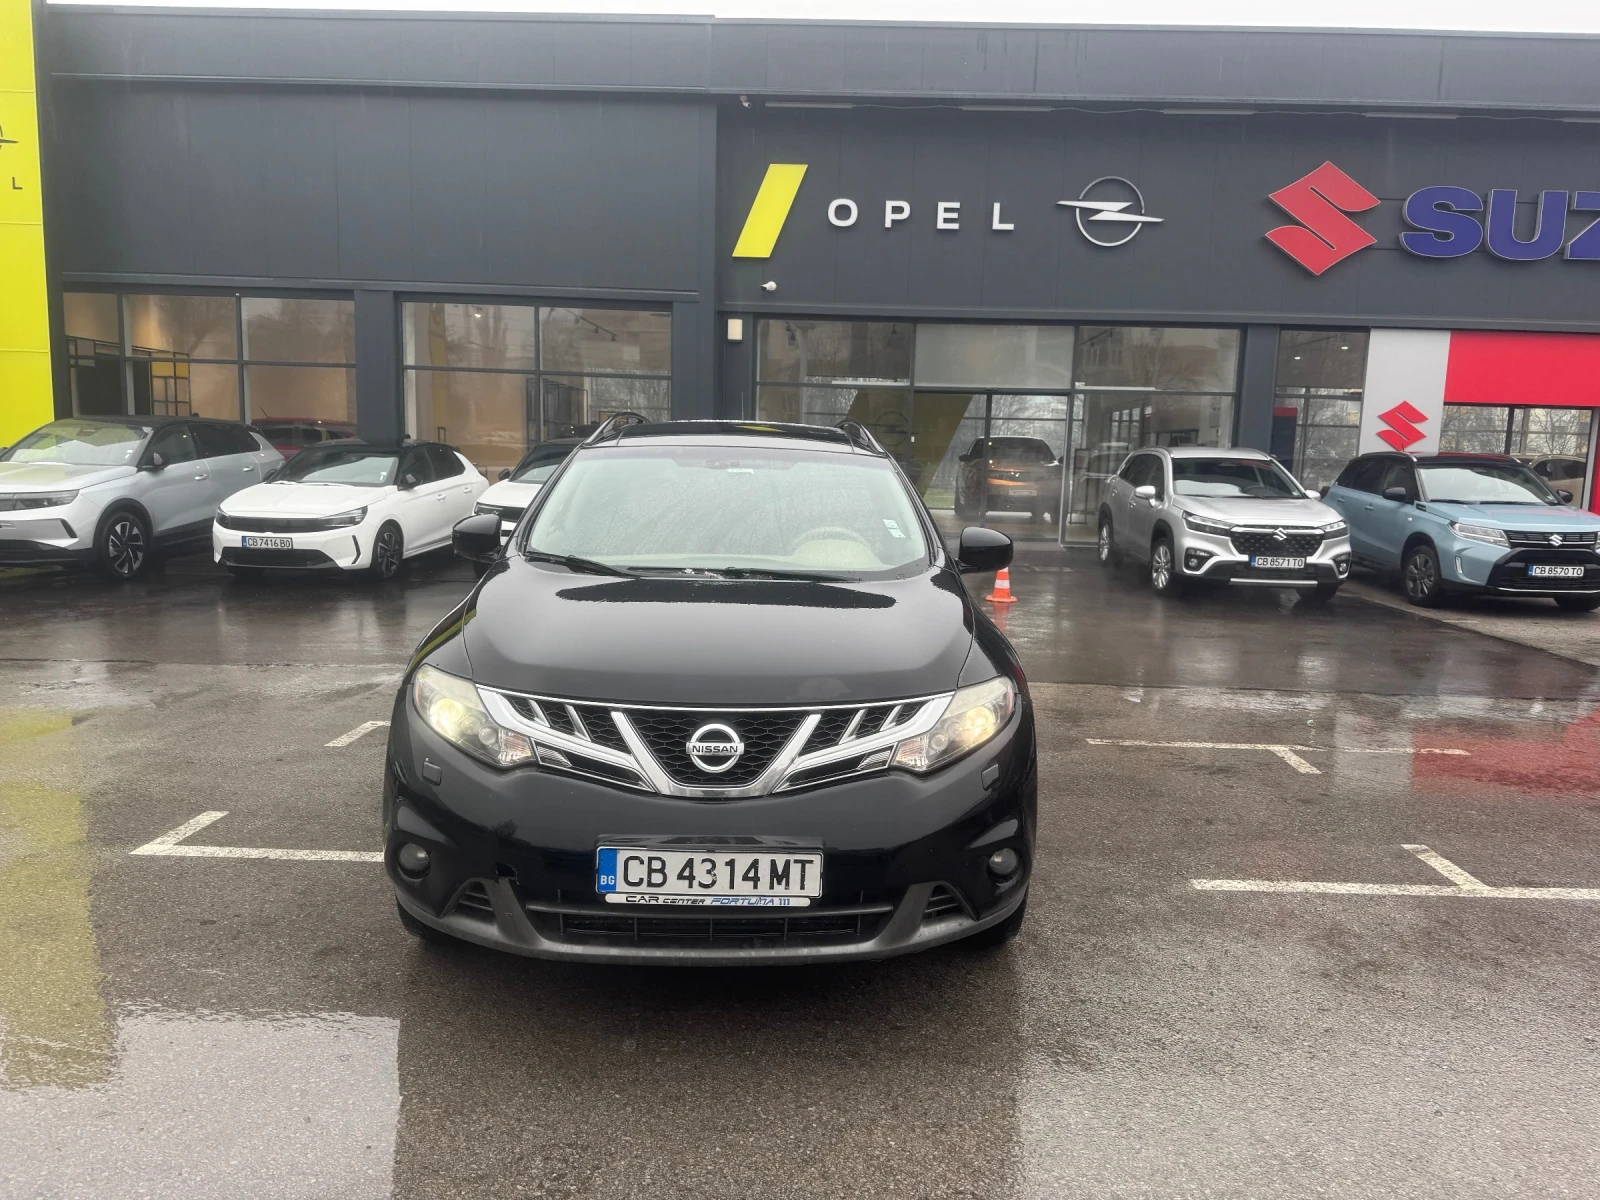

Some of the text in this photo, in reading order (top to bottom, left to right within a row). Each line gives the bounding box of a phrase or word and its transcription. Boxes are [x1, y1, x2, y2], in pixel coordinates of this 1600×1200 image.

[828, 198, 1015, 231] OPEL
[247, 537, 258, 547] CB
[259, 538, 279, 548] 7416
[1256, 557, 1269, 566] CB
[1269, 557, 1290, 567] 8571
[1534, 566, 1546, 575] CB
[1547, 566, 1570, 576] 8570
[692, 745, 738, 753] NISSAN
[623, 855, 814, 891] CB 4314 MT
[600, 875, 615, 886] BG
[625, 895, 660, 904] CAR
